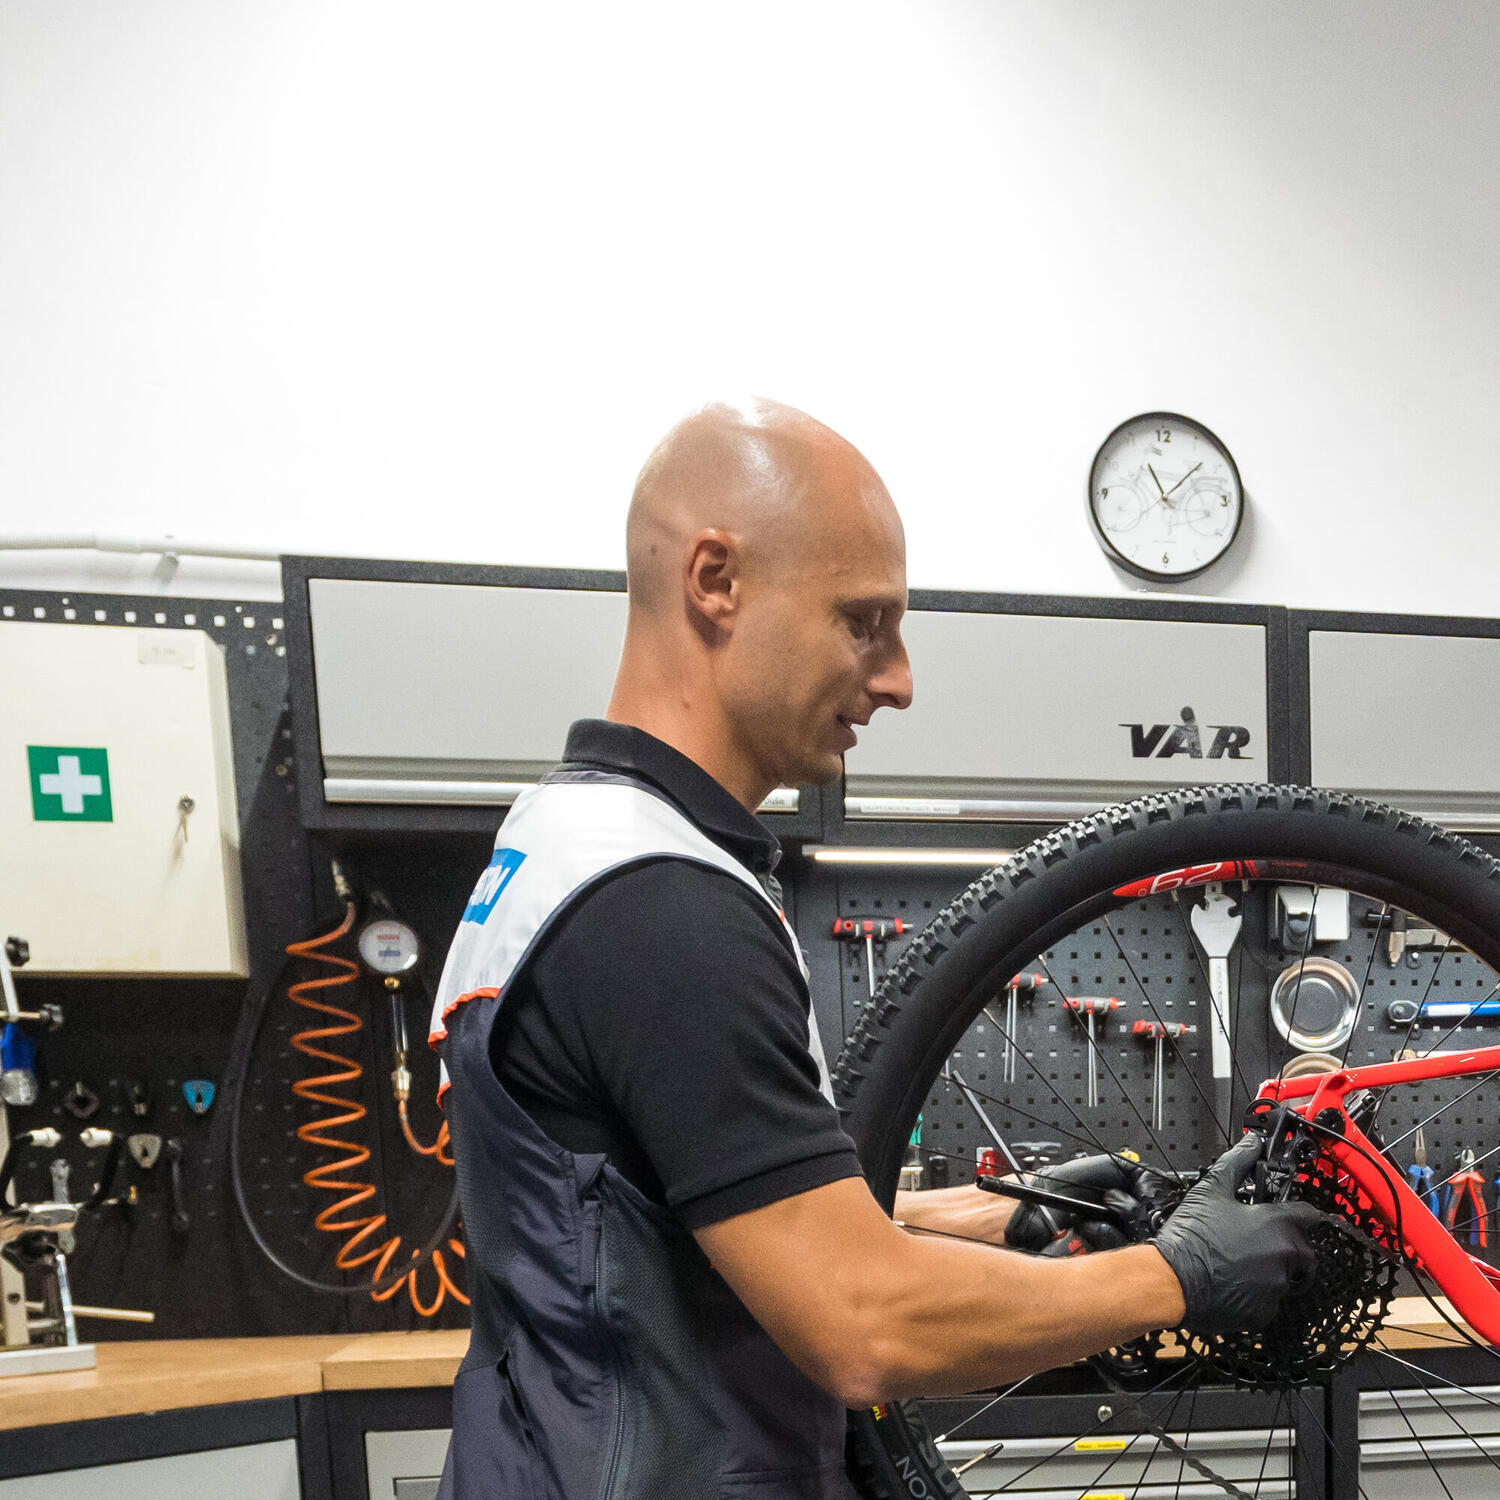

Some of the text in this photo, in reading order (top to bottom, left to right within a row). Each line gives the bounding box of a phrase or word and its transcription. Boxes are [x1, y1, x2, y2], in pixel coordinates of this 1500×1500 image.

[1156, 430, 1171, 442] 12
[1101, 488, 1109, 499] 9
[1220, 495, 1228, 507] 3
[1162, 552, 1169, 564] 6
[1118, 724, 1254, 759] VAR
